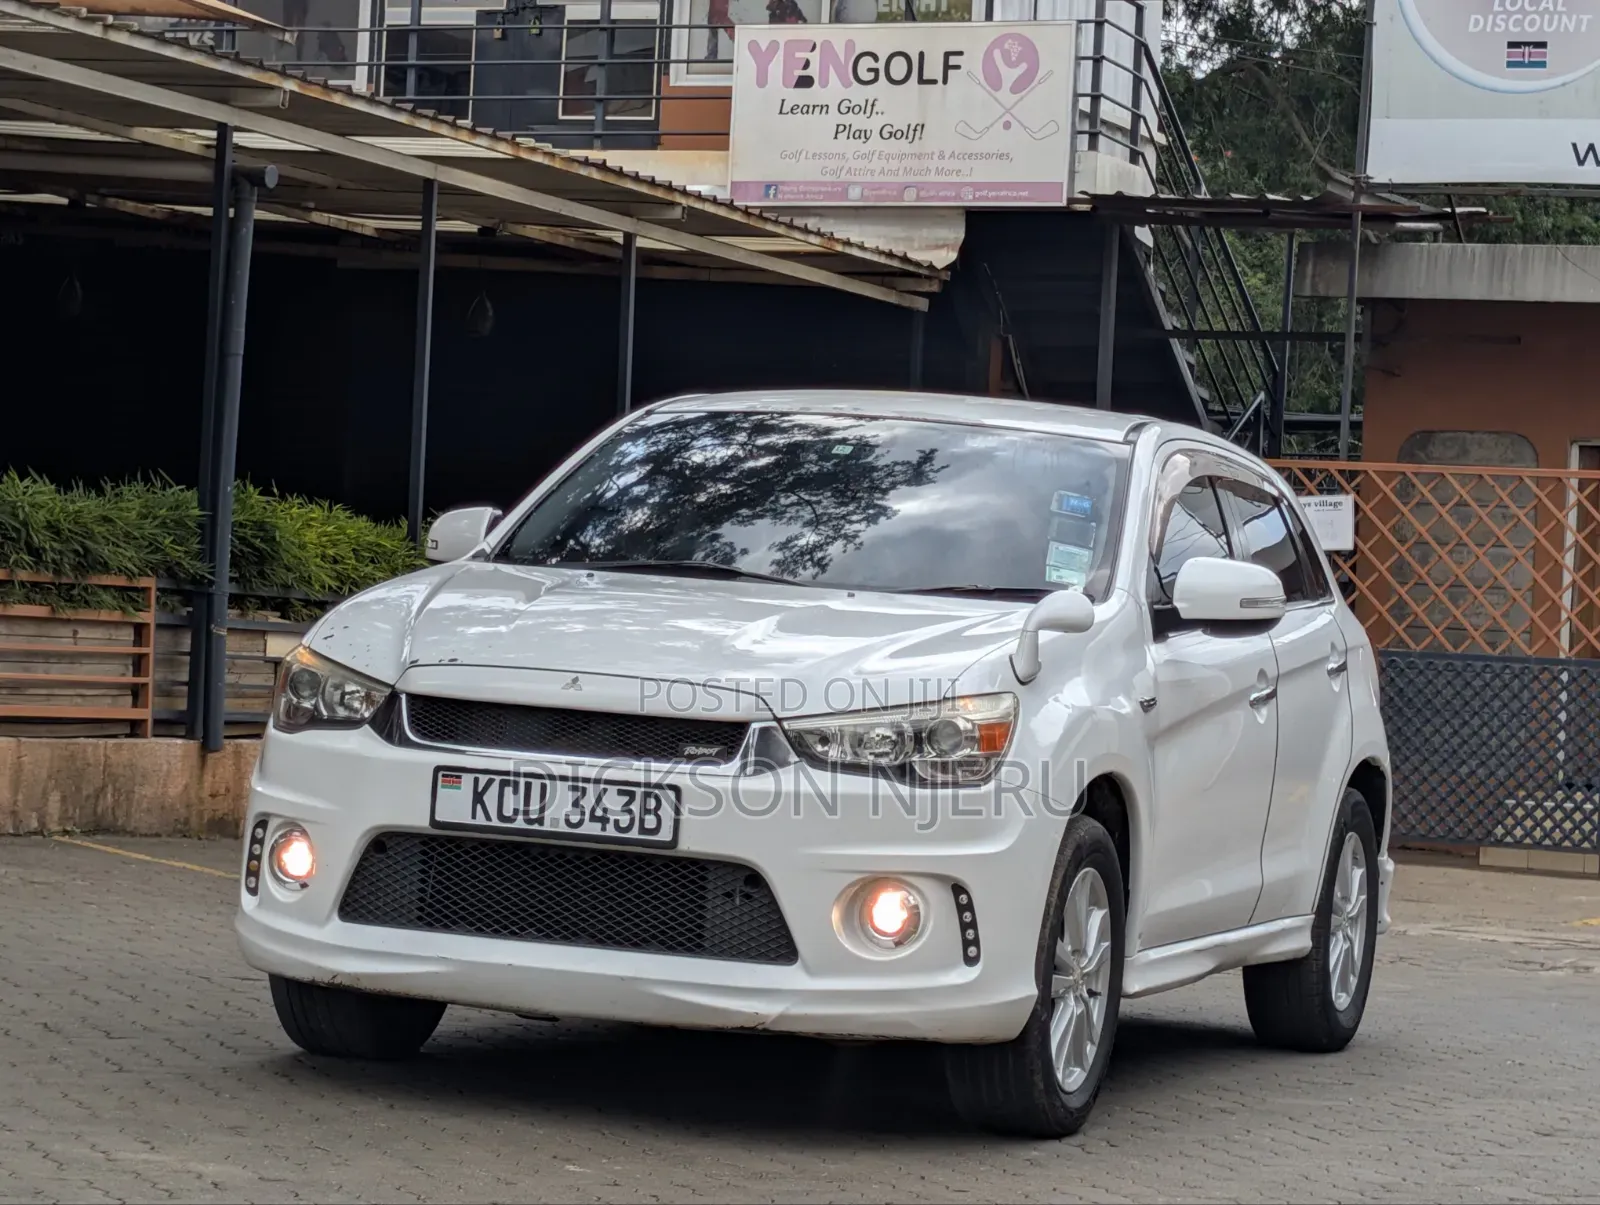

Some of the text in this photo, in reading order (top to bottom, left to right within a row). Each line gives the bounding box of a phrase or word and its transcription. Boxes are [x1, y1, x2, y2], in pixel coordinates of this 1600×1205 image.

[1492, 0, 1568, 12] LOCAL
[1468, 13, 1593, 33] DISCOUNT
[778, 98, 885, 119] Learn Golf..
[833, 123, 925, 144] Play Golf!
[780, 149, 1014, 164] Golf Lessons, Golf Equipment & Accessories,
[820, 165, 845, 180] Golf
[845, 166, 877, 177] Attire
[878, 166, 900, 177] And
[902, 166, 932, 177] Much
[1314, 499, 1344, 508] village
[471, 776, 663, 837] KCU 343B
